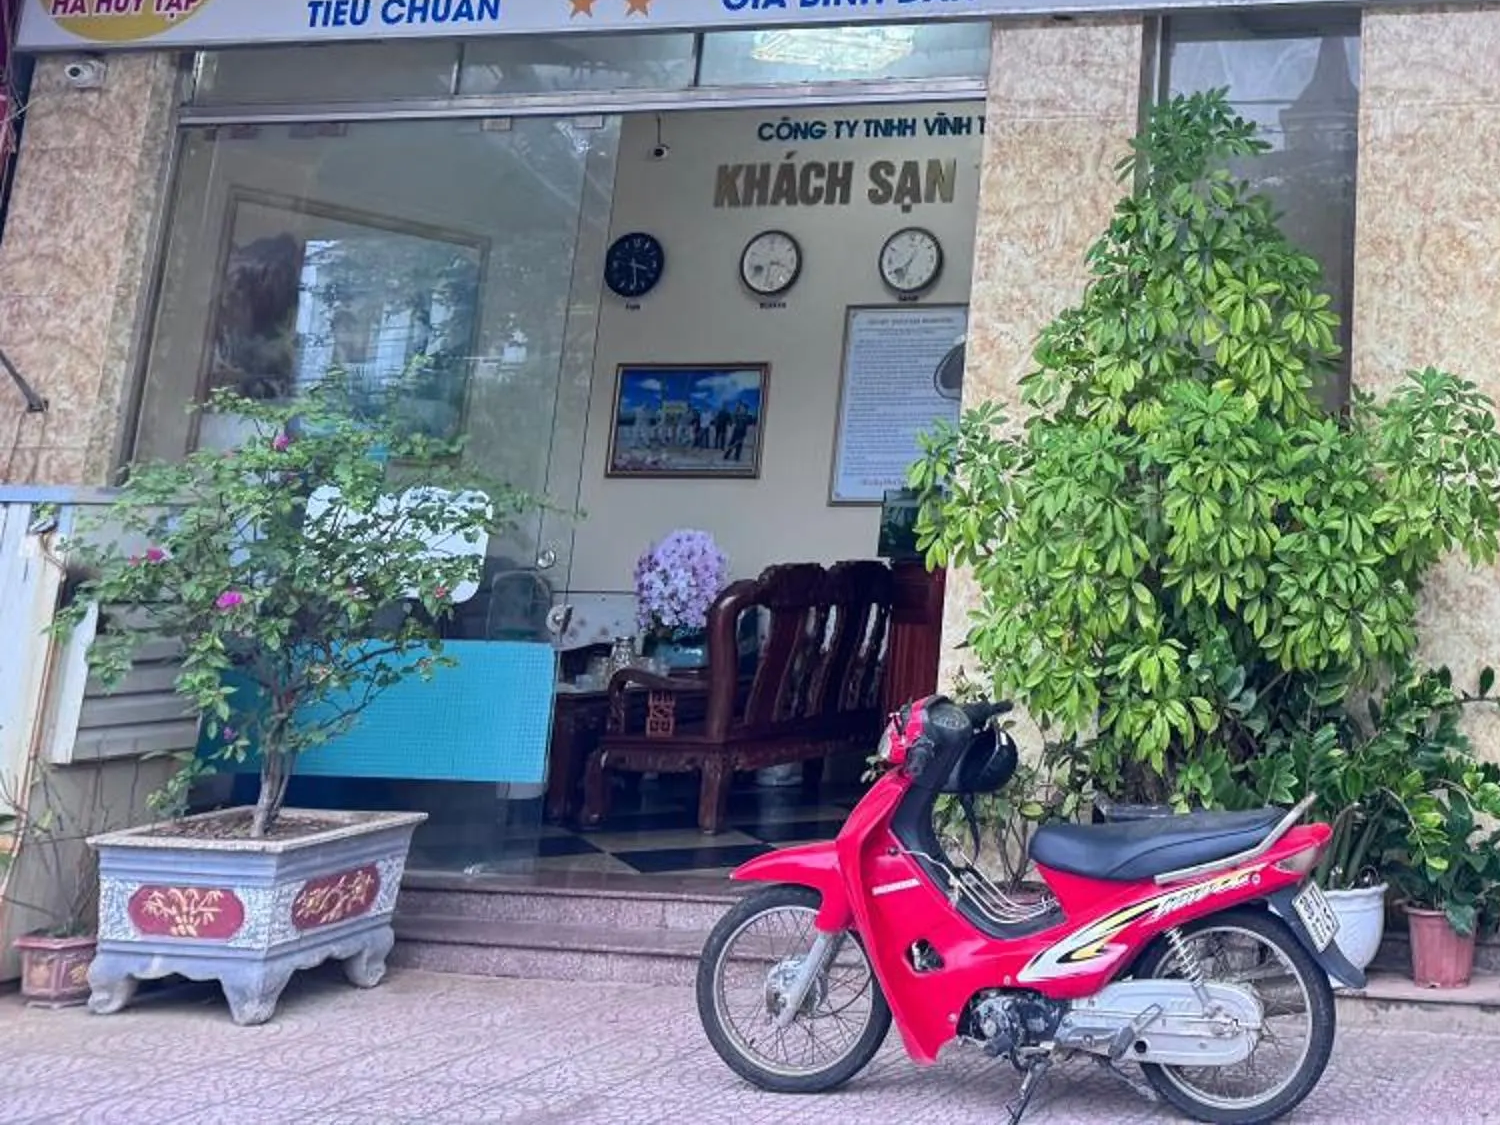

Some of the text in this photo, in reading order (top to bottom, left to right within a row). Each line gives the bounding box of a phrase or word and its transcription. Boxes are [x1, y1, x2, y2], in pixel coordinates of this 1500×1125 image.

[757, 116, 828, 142] CÔNG
[833, 120, 860, 140] TY
[863, 118, 917, 138] TNHH
[712, 150, 957, 214] KHÁCH SẠN
